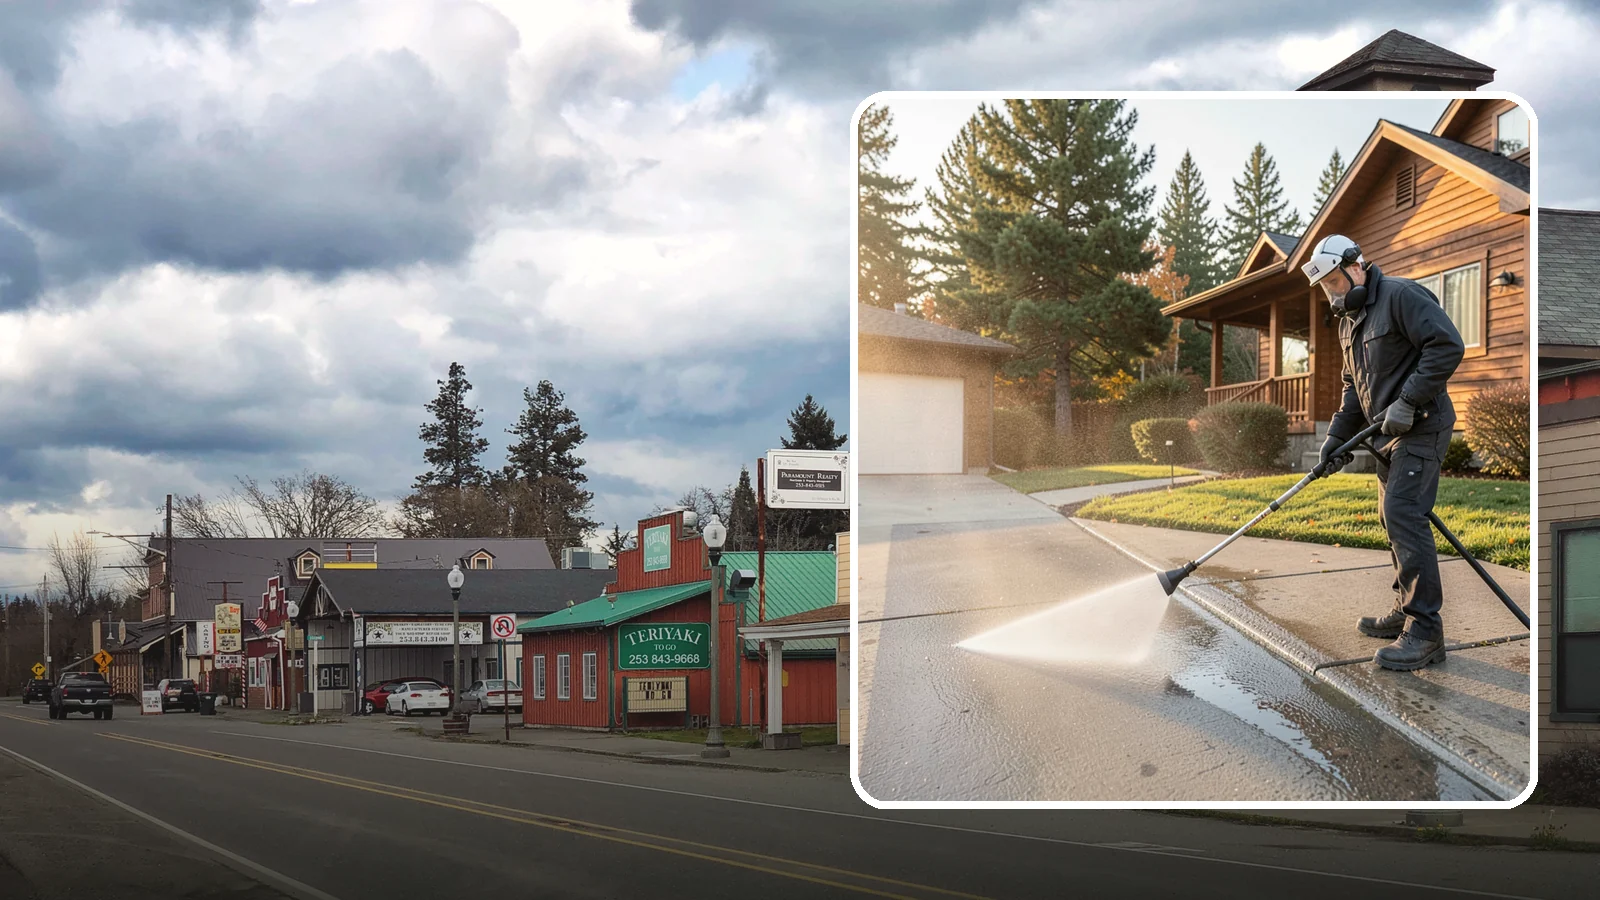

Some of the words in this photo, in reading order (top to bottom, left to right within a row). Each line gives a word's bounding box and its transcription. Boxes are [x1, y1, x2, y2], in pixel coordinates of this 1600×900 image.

[781, 471, 814, 479] PARAMOUNT
[625, 628, 702, 646] TERIYAKI
[629, 655, 648, 664] 253
[652, 654, 700, 664] 843-9668
[639, 682, 672, 690] TERIYAKI
